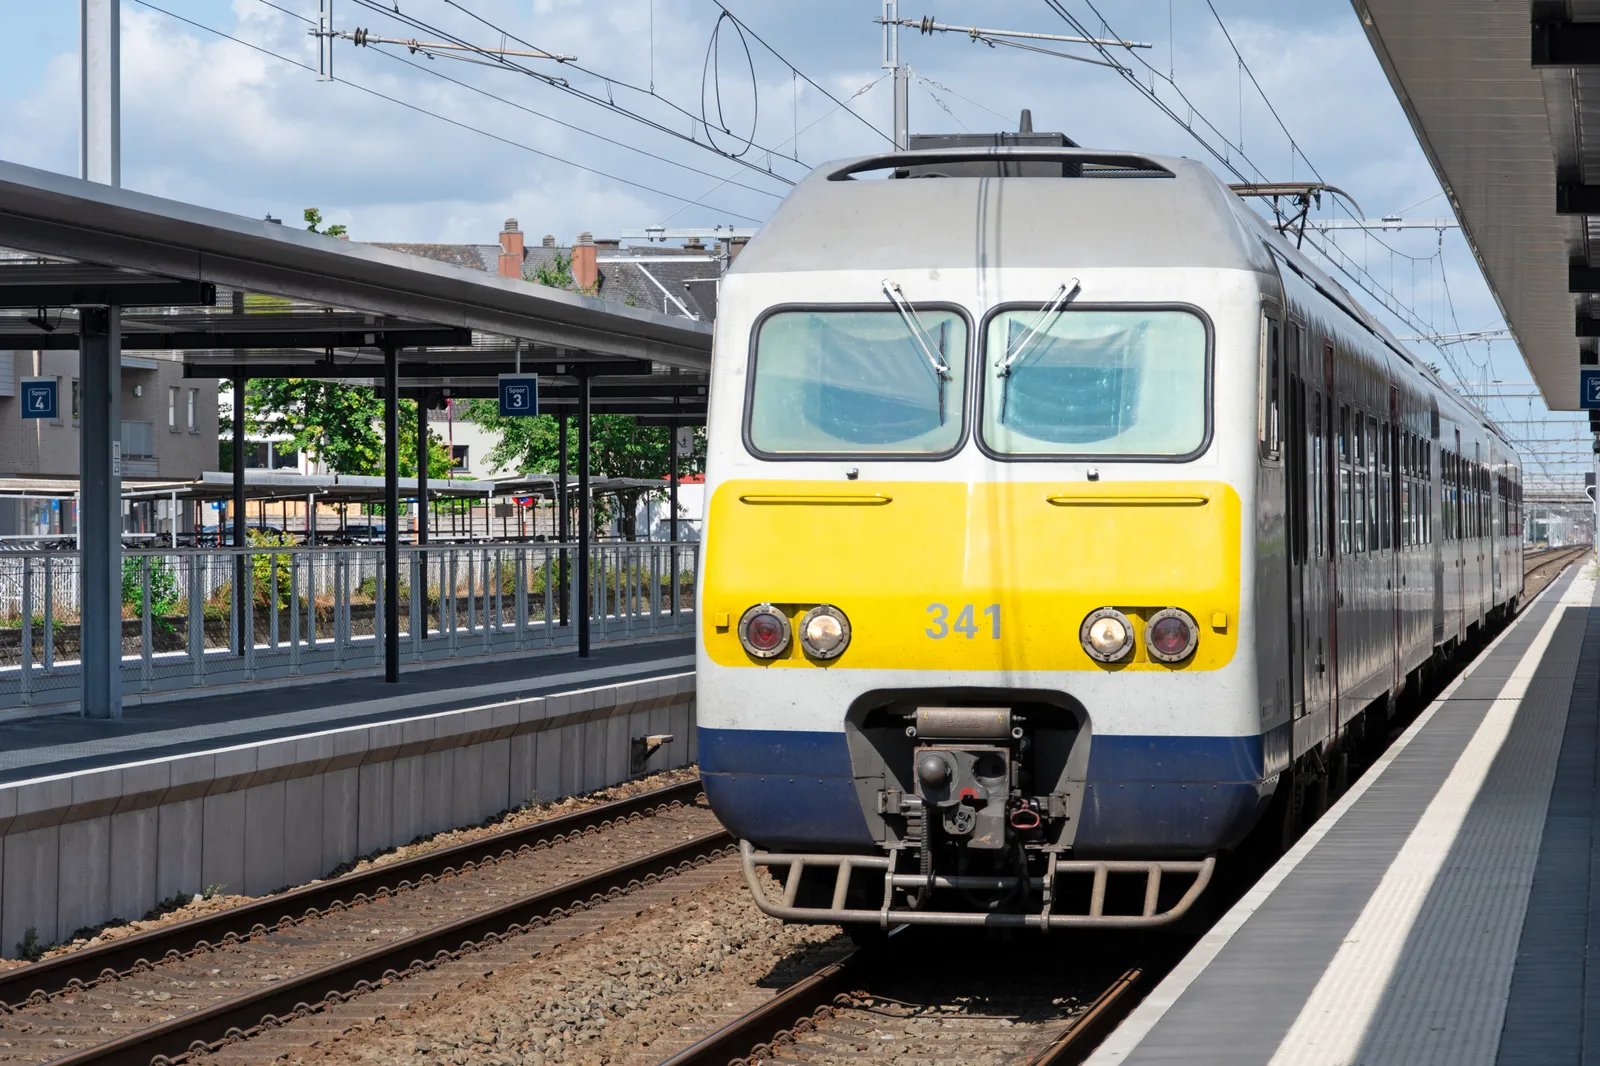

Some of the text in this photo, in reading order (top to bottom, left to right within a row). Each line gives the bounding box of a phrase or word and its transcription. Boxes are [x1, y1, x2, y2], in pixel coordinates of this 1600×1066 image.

[35, 396, 45, 410] 4
[513, 394, 522, 407] 3
[925, 602, 1001, 640] 341
